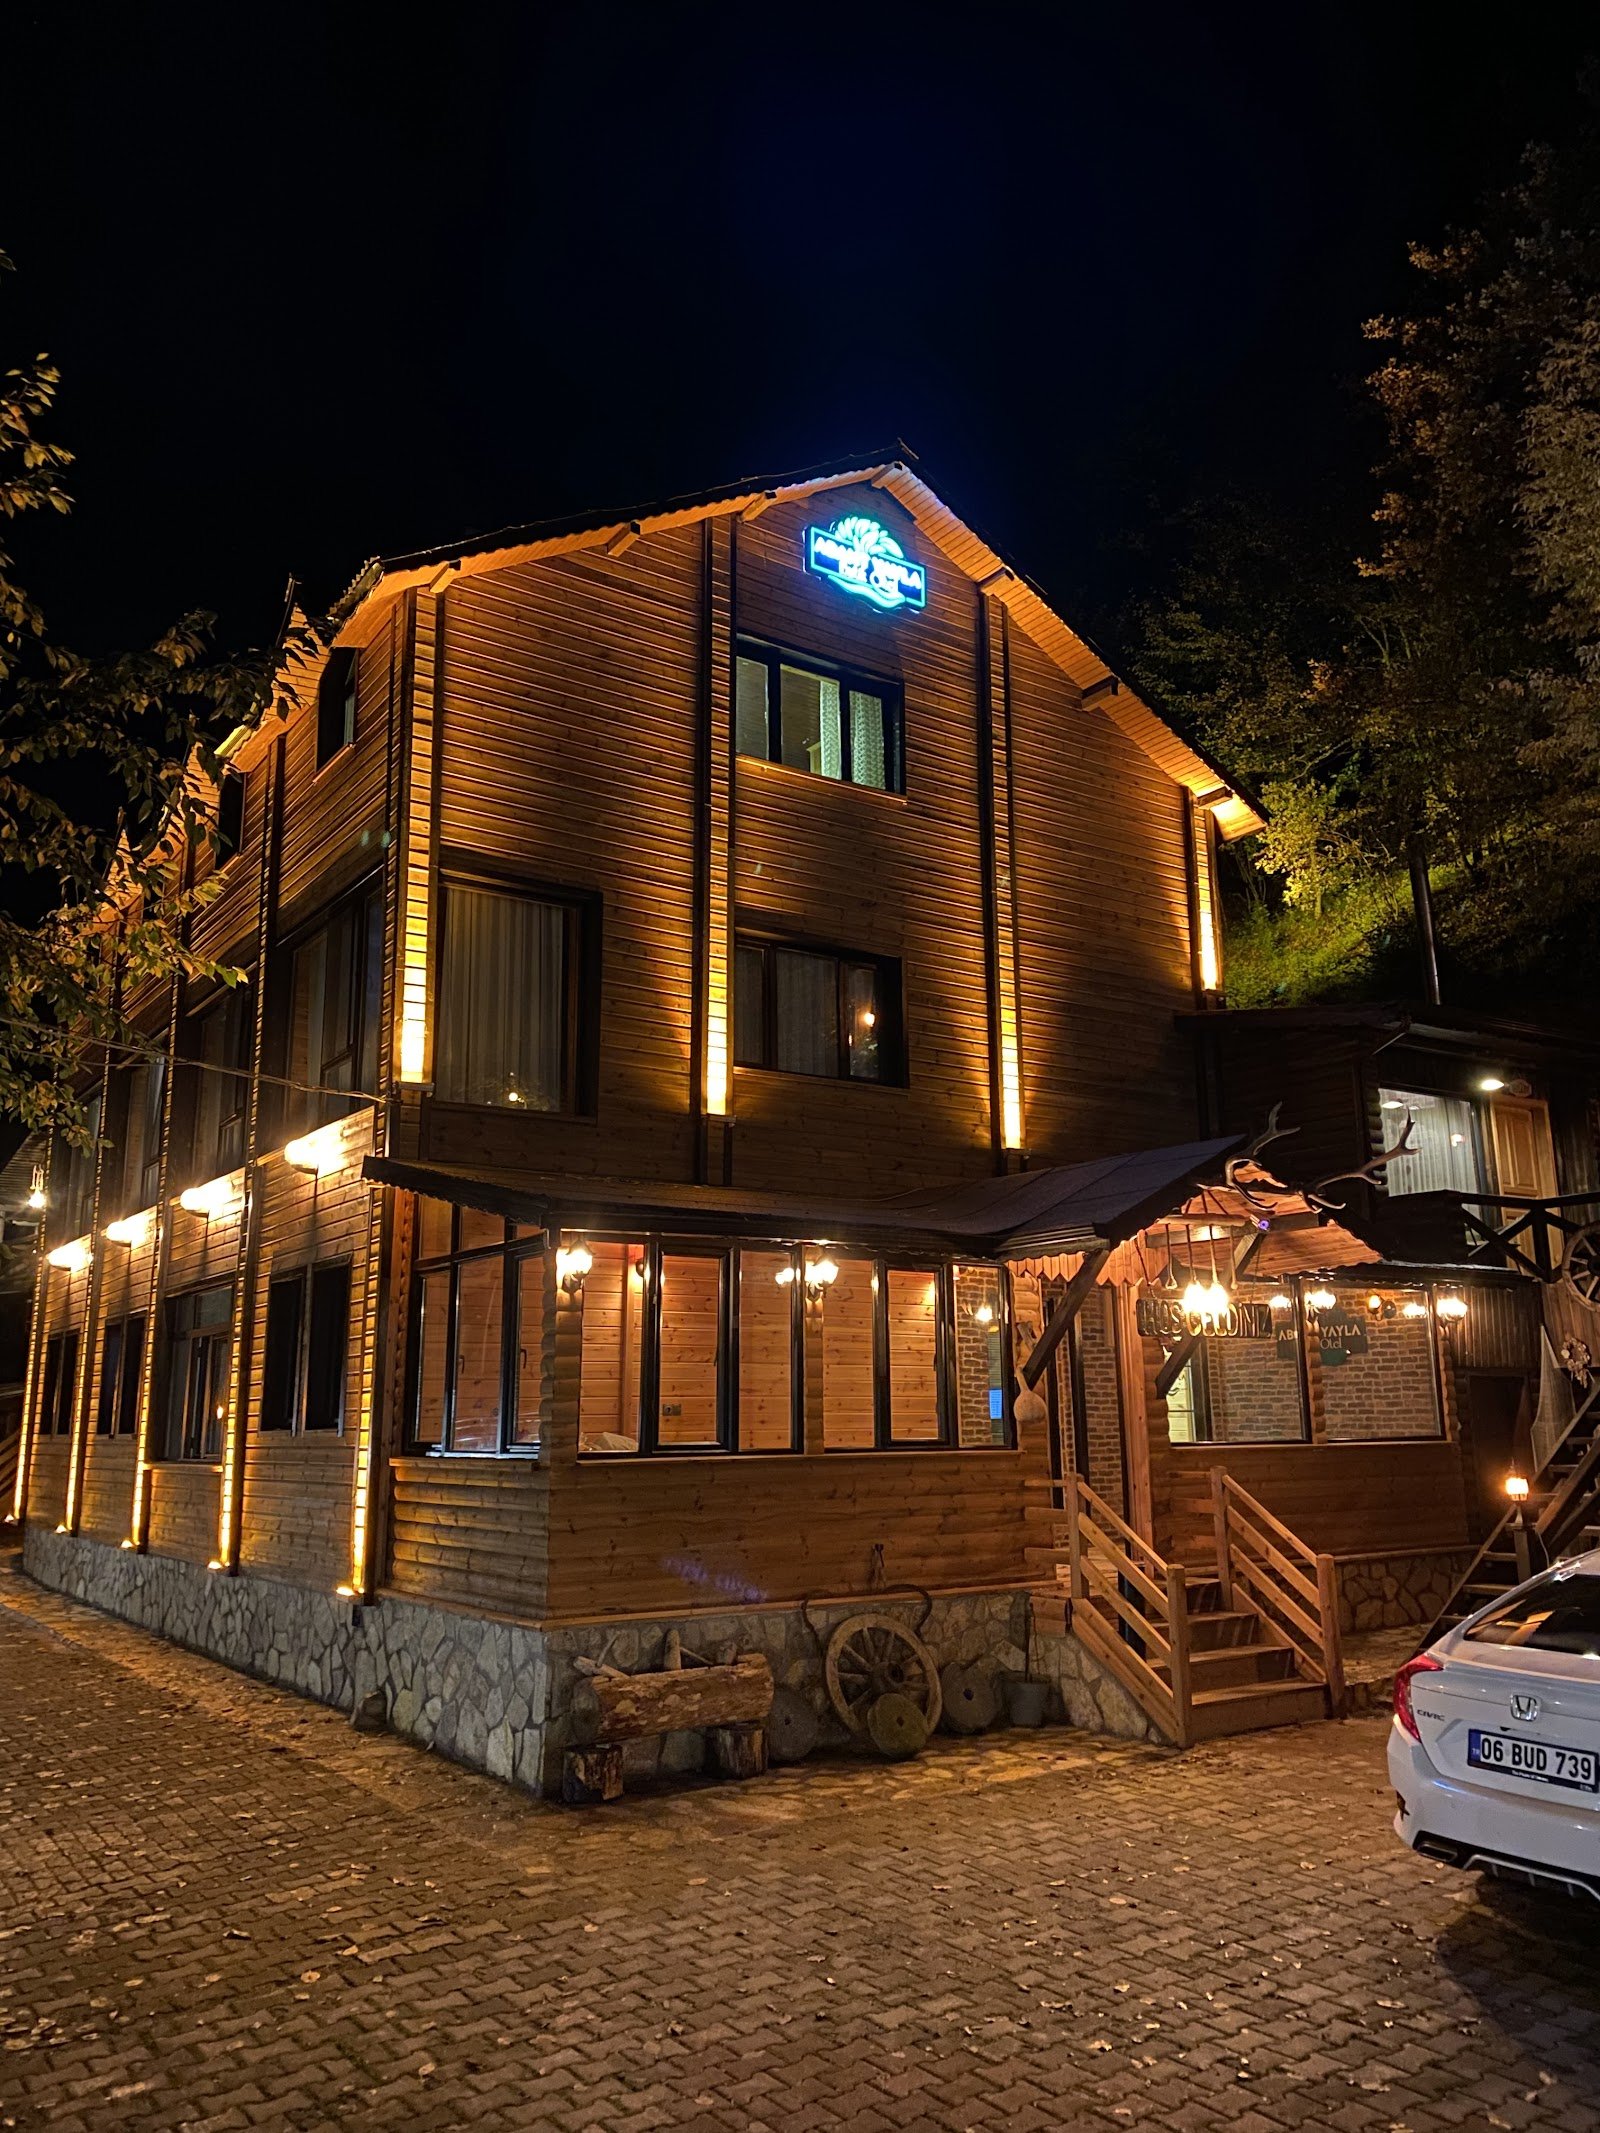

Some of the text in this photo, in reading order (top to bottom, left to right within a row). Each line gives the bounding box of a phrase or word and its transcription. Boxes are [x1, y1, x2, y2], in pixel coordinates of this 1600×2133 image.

[1320, 1324, 1361, 1338] YAYLA
[1416, 1709, 1445, 1722] CIVIC
[1481, 1737, 1504, 1762] 06
[1511, 1743, 1547, 1771] BUD
[1555, 1751, 1592, 1780] 739
